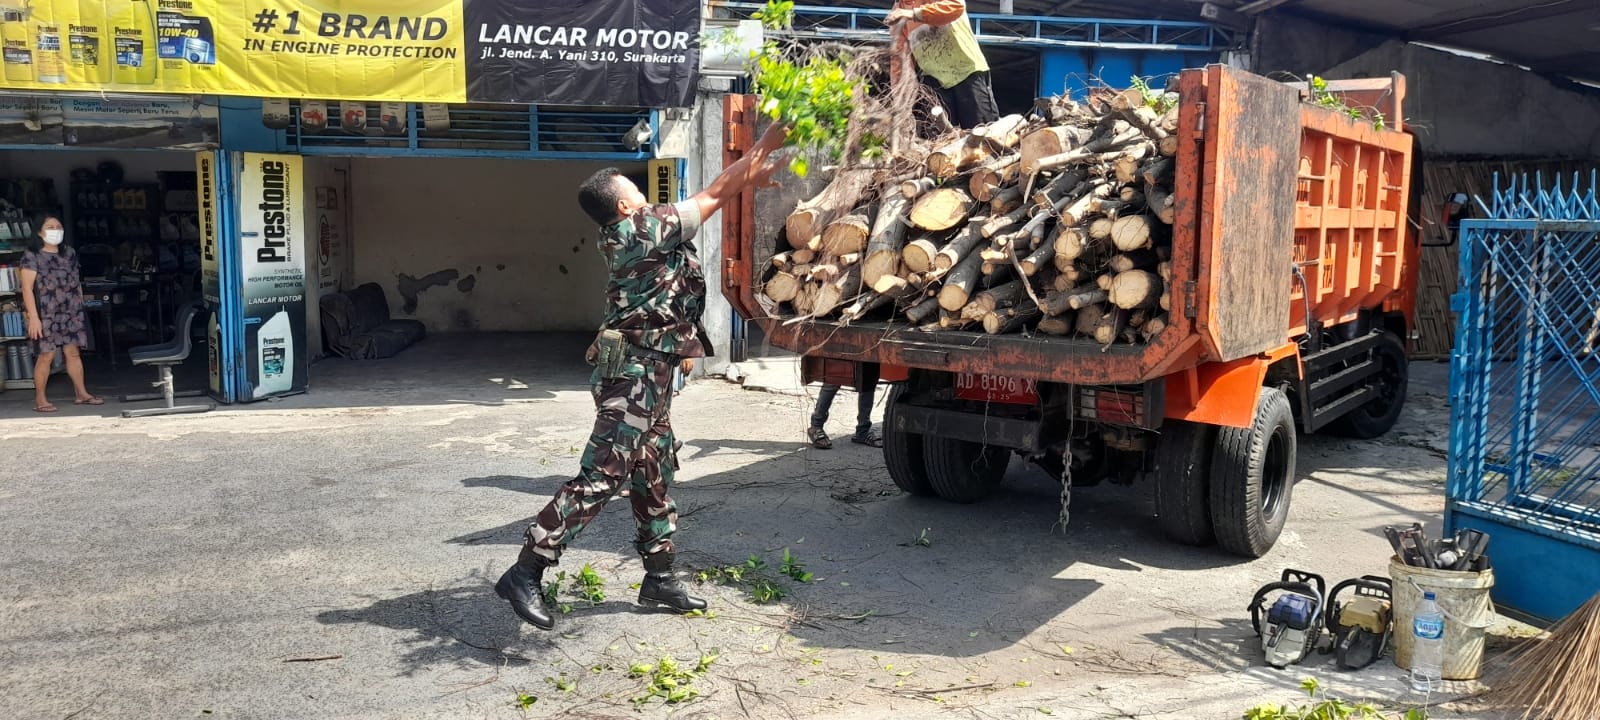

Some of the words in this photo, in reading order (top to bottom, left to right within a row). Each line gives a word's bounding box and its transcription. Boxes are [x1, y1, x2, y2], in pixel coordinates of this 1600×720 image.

[159, 28, 199, 38] 10W-40
[252, 8, 300, 35] #1
[317, 12, 448, 41] BRAND
[479, 23, 587, 47] LANCAR
[595, 28, 689, 50] MOTOR
[242, 38, 265, 51] IN
[271, 40, 340, 55] ENGINE
[345, 44, 456, 59] PROTECTION
[499, 47, 535, 60] Jend.
[539, 49, 553, 60] A.
[558, 49, 588, 61] Yani
[590, 51, 619, 64] 310,
[623, 51, 686, 64] Surakarta
[202, 158, 213, 260] Prestone
[257, 161, 286, 263] Prestone
[248, 295, 277, 305] LANCAR
[277, 294, 302, 303] MOTOR
[956, 372, 974, 389] AD
[981, 374, 1016, 393] 8196
[1025, 377, 1034, 394] X
